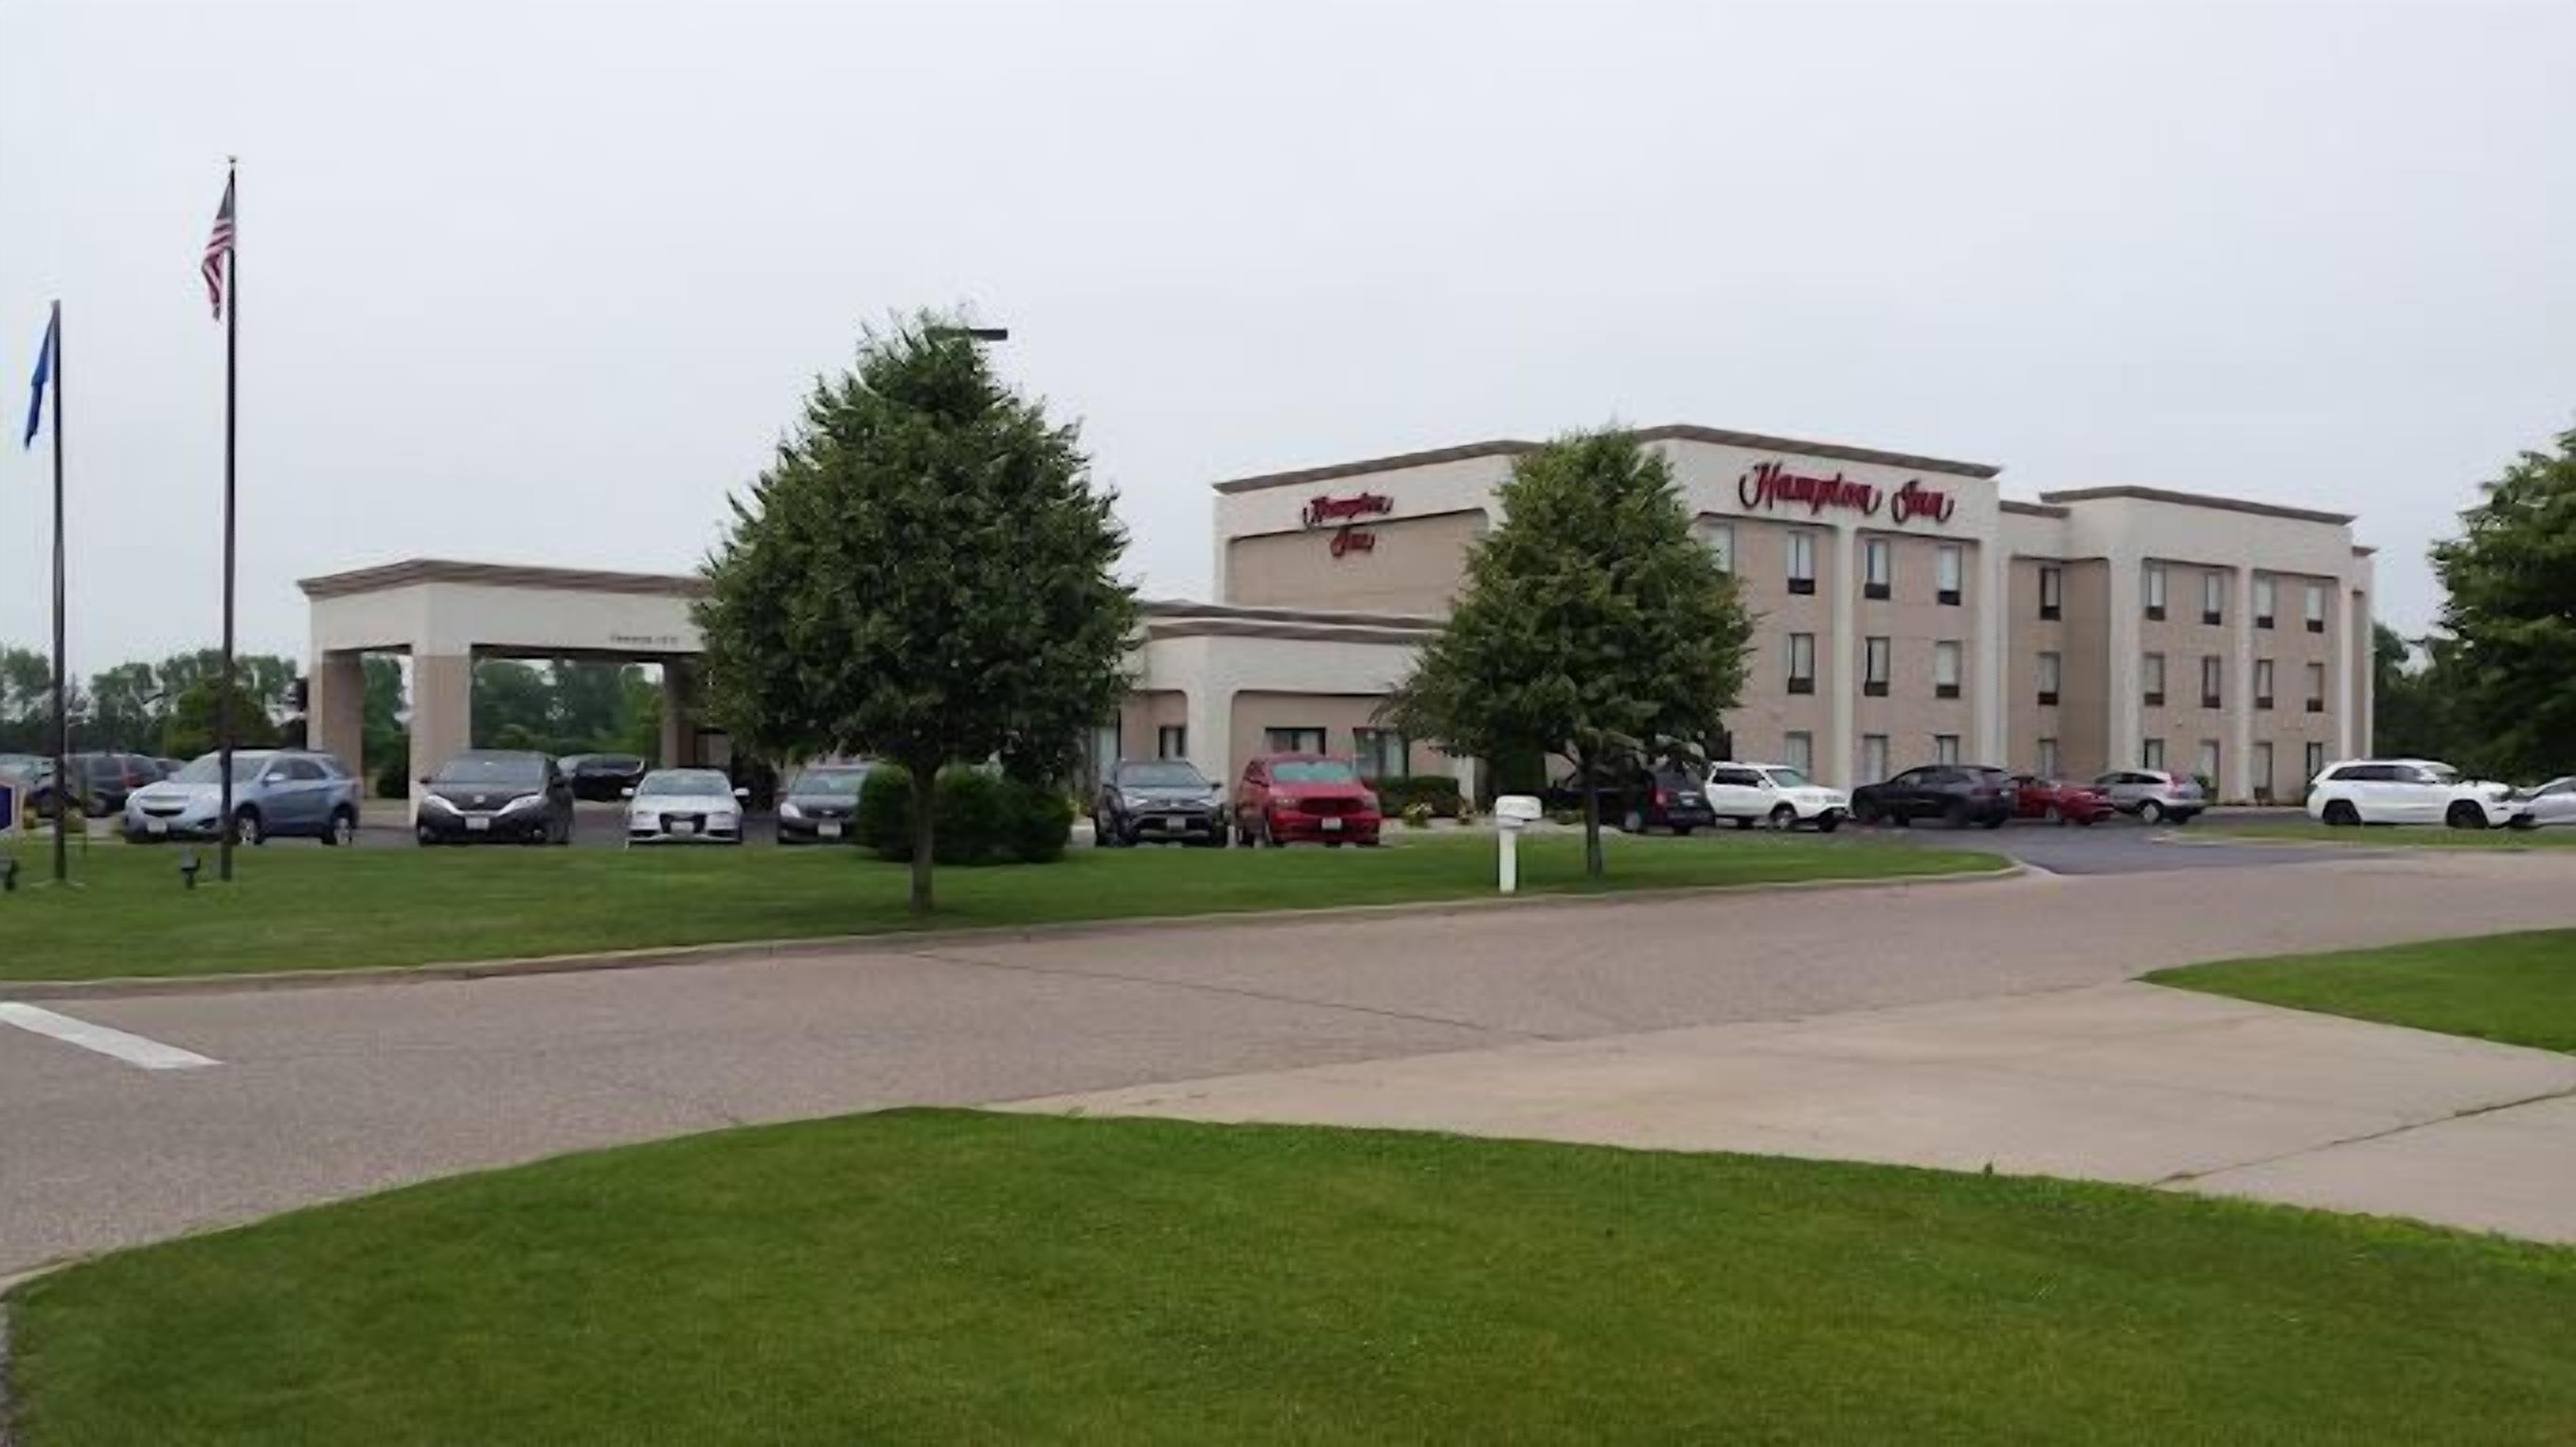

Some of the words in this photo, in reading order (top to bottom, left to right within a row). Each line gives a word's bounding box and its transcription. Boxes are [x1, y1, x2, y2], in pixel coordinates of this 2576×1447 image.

[1303, 492, 1394, 524] Hampton
[1739, 461, 1883, 515] Hampton
[1891, 478, 1955, 525] Inn
